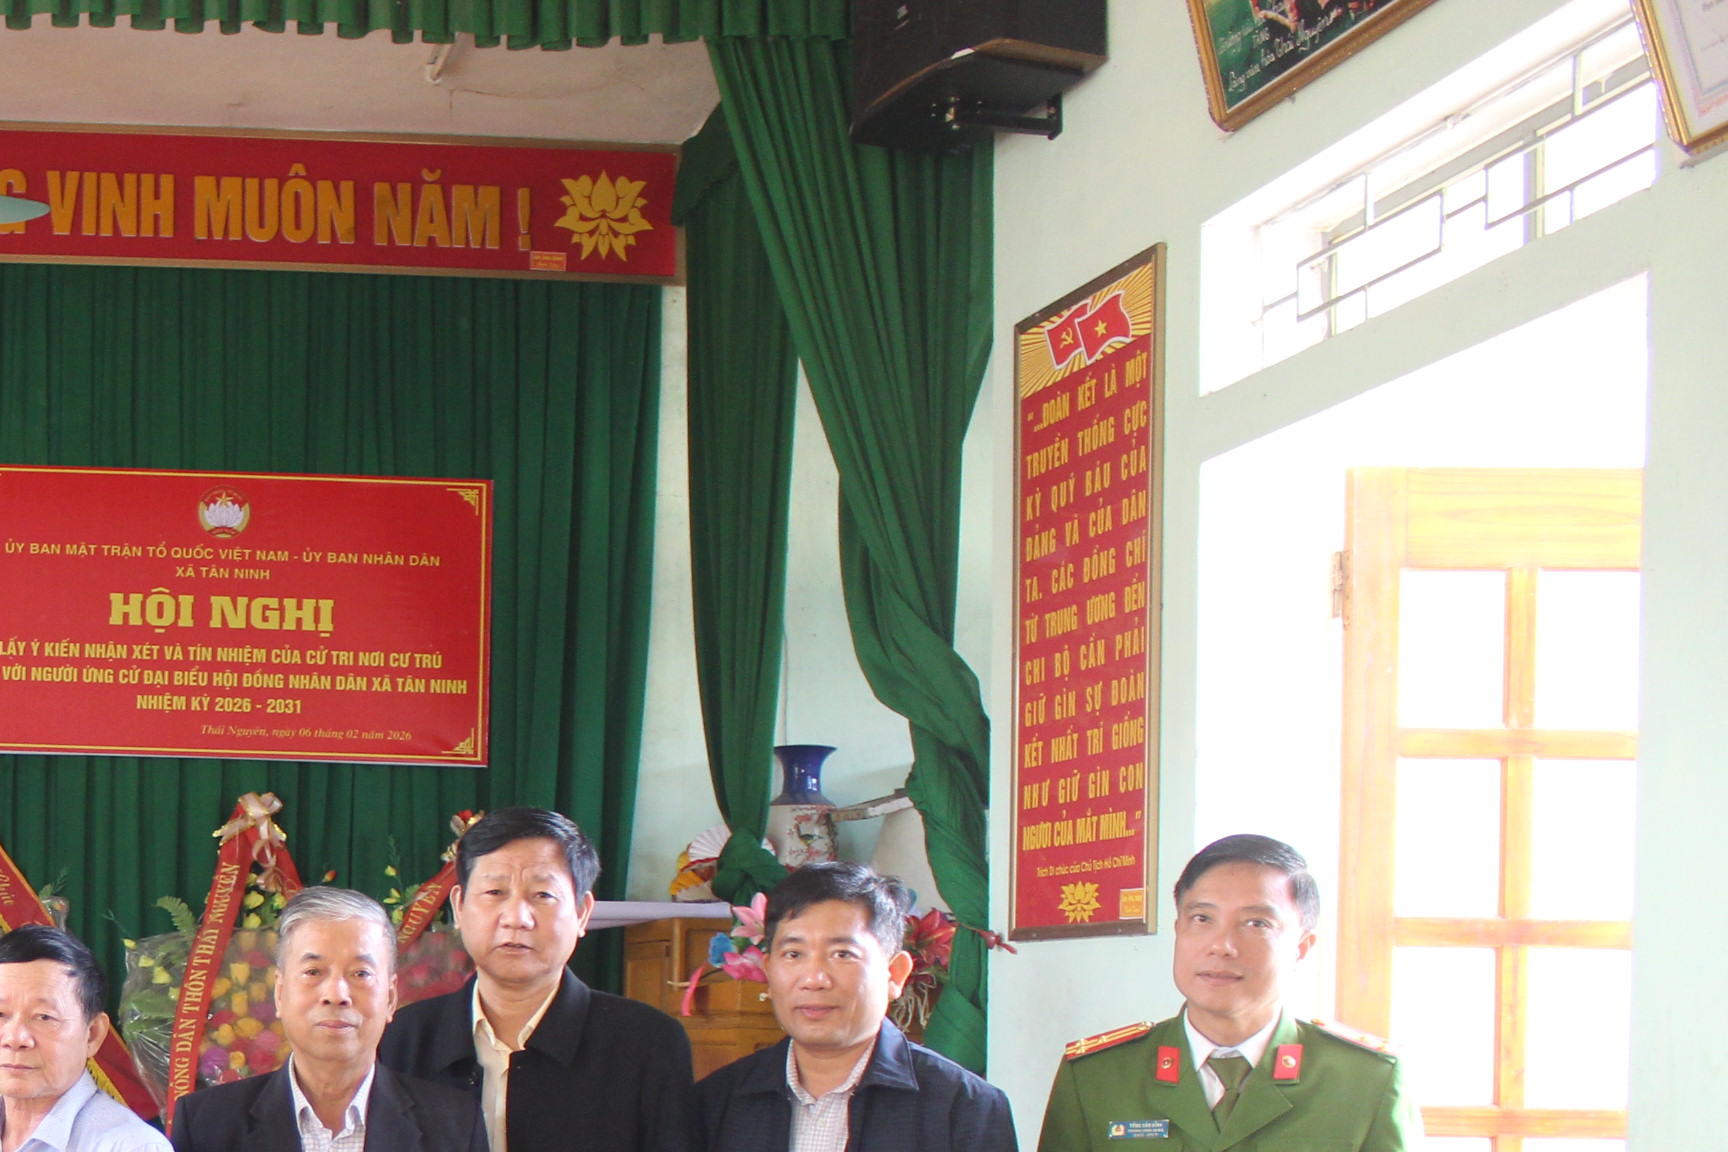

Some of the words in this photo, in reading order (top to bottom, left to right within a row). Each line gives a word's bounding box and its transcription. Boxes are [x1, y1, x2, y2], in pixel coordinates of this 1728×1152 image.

[47, 170, 174, 238] VINH
[194, 164, 355, 244] MUÔN
[374, 167, 500, 250] NĂM
[517, 188, 531, 251] !
[5, 539, 25, 553] ỦY
[30, 543, 60, 554] BAN
[66, 543, 97, 556] MẶT
[101, 543, 142, 556] TRẬN
[147, 542, 167, 557] TỔ
[171, 544, 213, 559] QUỐC
[219, 547, 252, 561] VIỆT
[256, 550, 288, 561] NAM
[303, 548, 322, 562] ỦY
[327, 552, 357, 563] BAN
[363, 552, 404, 565] NHÂN
[410, 553, 439, 566] DÂN
[176, 564, 195, 577] XÃ
[200, 565, 229, 578] TÂN
[234, 568, 270, 579] NINH
[109, 587, 194, 633] HỘI
[210, 596, 334, 637] NGHỊ
[0, 636, 26, 659] LẤY
[31, 639, 40, 656] Ý
[45, 638, 80, 657] KIẾN
[85, 641, 127, 661] NHẬN
[132, 642, 160, 659] XÉT
[164, 643, 183, 660] VÀ
[188, 644, 212, 661] TÍN
[217, 645, 266, 665] NHIỆM
[271, 645, 301, 664] CỦA
[306, 646, 328, 665] CỬ
[331, 651, 353, 665] TRI
[359, 651, 384, 666] NƠI
[390, 653, 411, 667] CƯ
[414, 652, 442, 668] TRÚ
[1025, 657, 1045, 686] CHI
[1054, 644, 1070, 681] BỘ
[1079, 632, 1106, 671] CẦN
[1115, 616, 1145, 661] PHẢI
[2, 664, 26, 680] VỚI
[31, 665, 77, 682] NGƯỜI
[83, 665, 114, 683] ỨNG
[119, 665, 141, 684] CỬ
[144, 670, 168, 687] ĐẠI
[174, 666, 208, 686] BIỂU
[213, 670, 237, 689] HỘI
[242, 669, 284, 688] ĐỒNG
[289, 672, 331, 689] NHÂN
[336, 673, 367, 690] DÂN
[372, 675, 391, 691] XÃ
[396, 675, 425, 692] TÂN
[430, 679, 467, 694] NINH
[1024, 692, 1047, 727] GIỮ
[1054, 687, 1076, 721] GÌN
[1085, 681, 1103, 716] SỰ
[1110, 669, 1145, 707] ĐOÀN
[137, 693, 186, 713] NHIỆM
[191, 694, 210, 710] KỲ
[215, 697, 251, 712] 2026
[267, 699, 301, 713] 2031
[202, 725, 225, 734] Thái
[229, 726, 268, 737] Nguyên,
[272, 729, 296, 738] ngày
[299, 728, 311, 737] 06
[314, 728, 344, 740] tháng
[346, 730, 359, 738] 02
[362, 731, 384, 739] năm
[387, 731, 412, 740] 2026
[1023, 778, 1051, 810] NHƯ
[1058, 769, 1081, 804] GIỮ
[1088, 765, 1110, 799] GÌN
[1119, 761, 1144, 793] CON
[208, 862, 240, 924] NGUYÊN
[193, 927, 219, 967] THÁI
[183, 970, 207, 1013] THÔN
[174, 1018, 196, 1053] DÂN
[170, 1057, 189, 1101] NÔNG
